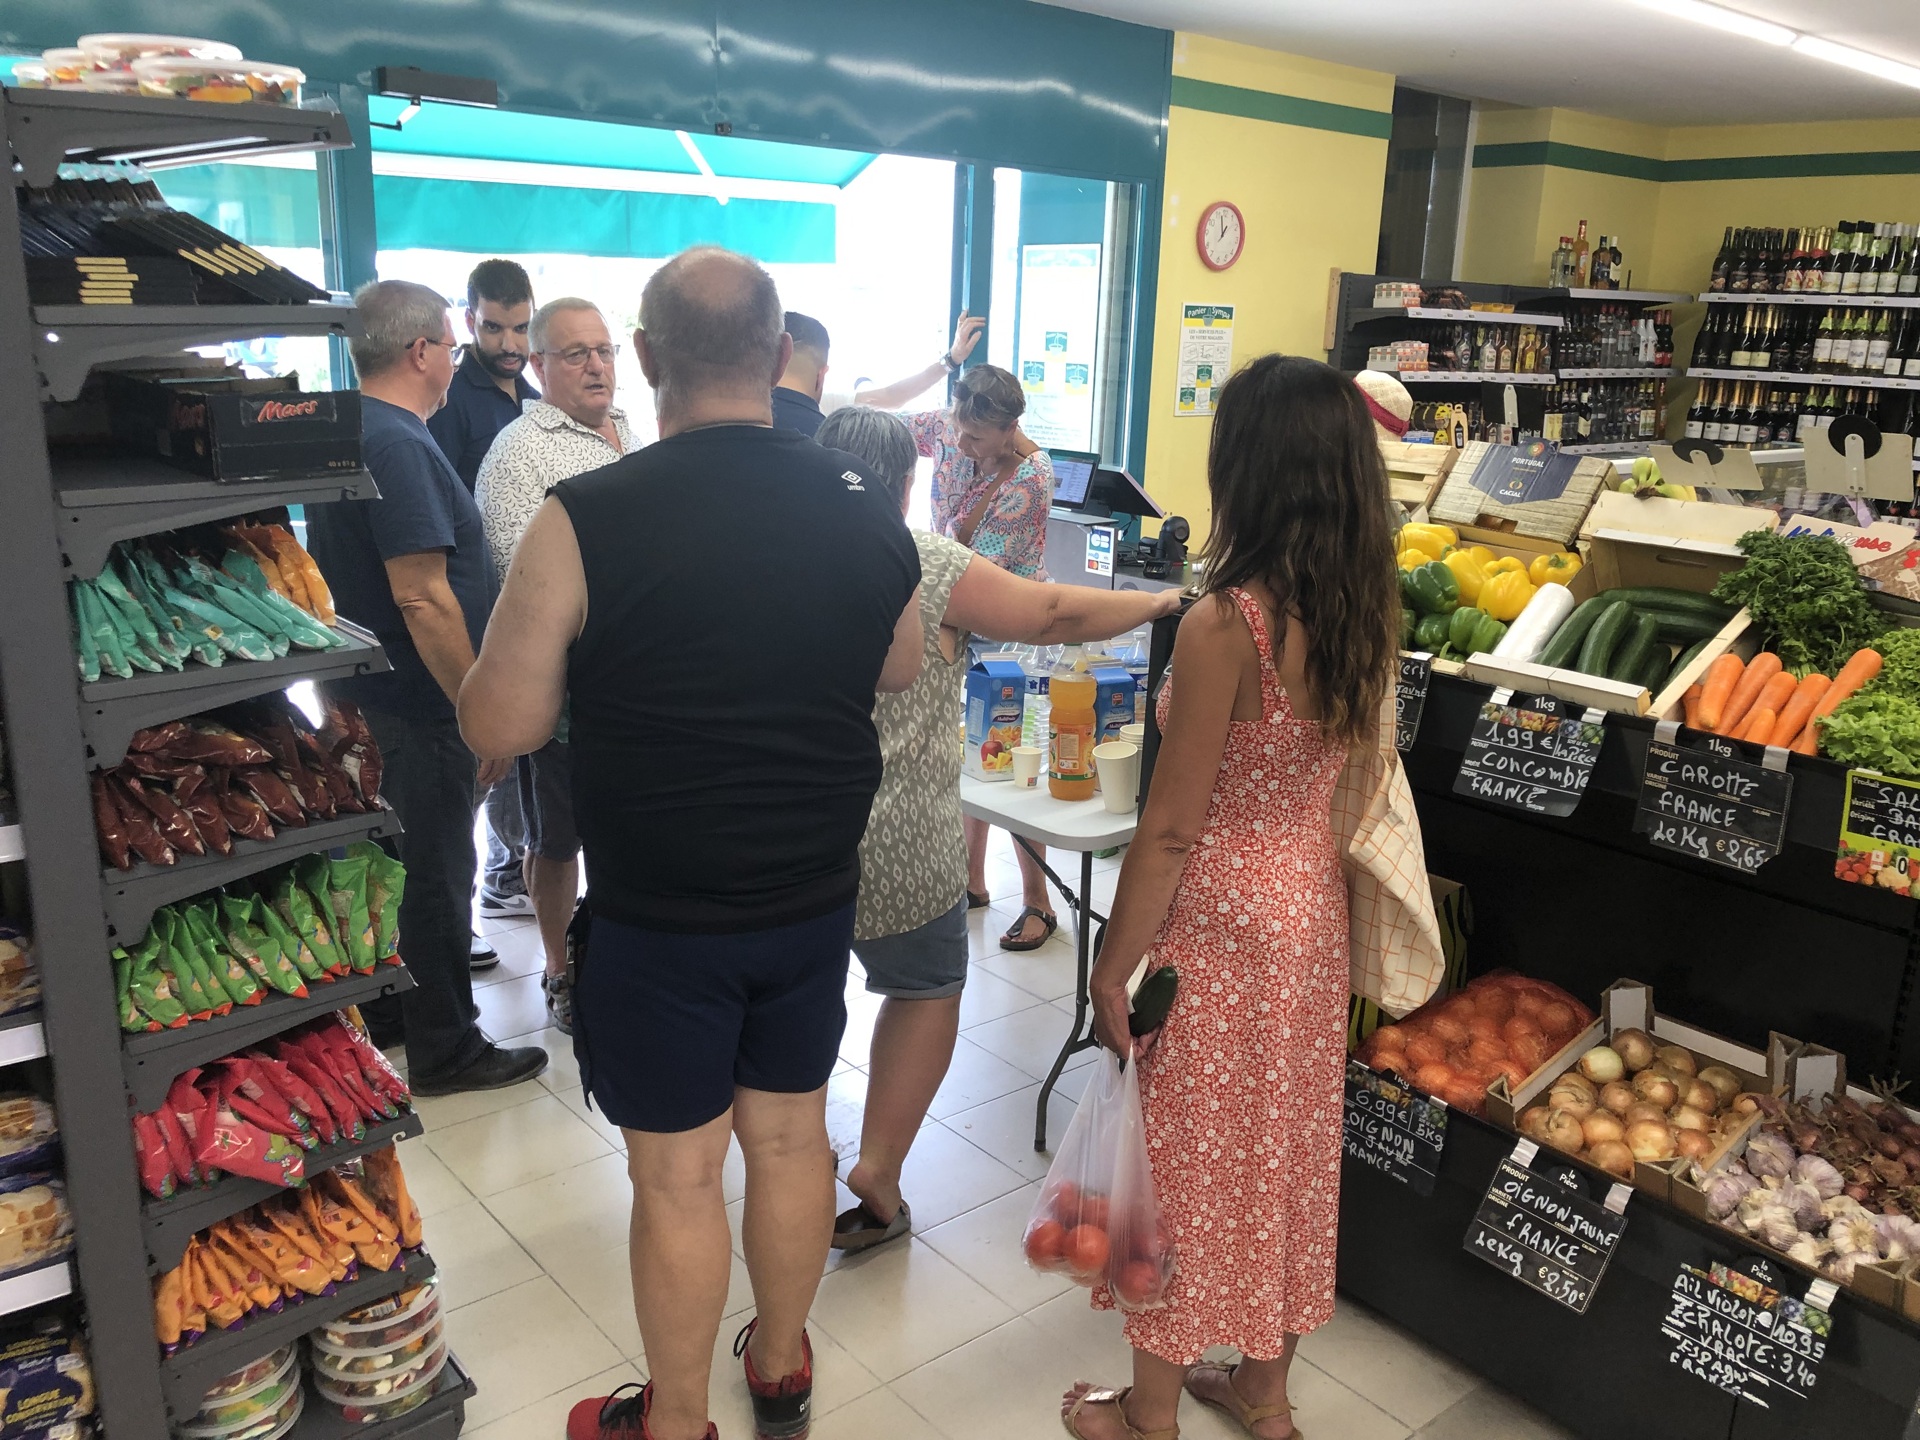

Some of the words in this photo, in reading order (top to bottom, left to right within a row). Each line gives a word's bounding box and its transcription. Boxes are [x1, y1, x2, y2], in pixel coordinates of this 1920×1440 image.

[1187, 306, 1206, 318] Panier
[1212, 306, 1230, 319] Sympa
[257, 400, 318, 423] Mars
[1511, 457, 1545, 468] PORTUGAL
[1499, 488, 1522, 498] CACIAL
[1534, 696, 1556, 712] 1kg
[1486, 722, 1534, 750] 1,99
[1540, 736, 1554, 750] €
[1650, 746, 1680, 760] PRODUIT
[1708, 738, 1732, 758] 1kg
[1852, 776, 1880, 788] Produit
[1716, 840, 1726, 852] €
[1726, 839, 1766, 868] 2,65
[1394, 1074, 1410, 1090] 1kg
[1356, 1090, 1396, 1122] 6,99
[1397, 1110, 1408, 1124] €
[1342, 1136, 1392, 1172] FRANCE
[1502, 1164, 1530, 1182] PRODUIT
[1558, 1174, 1579, 1190] Pièce
[1568, 1170, 1576, 1180] la
[1750, 1265, 1773, 1283] Pièce
[1538, 1266, 1548, 1279] €
[1543, 1272, 1579, 1304] 2,50
[1773, 1323, 1826, 1359] 10,95
[1780, 1353, 1817, 1387] 3,40
